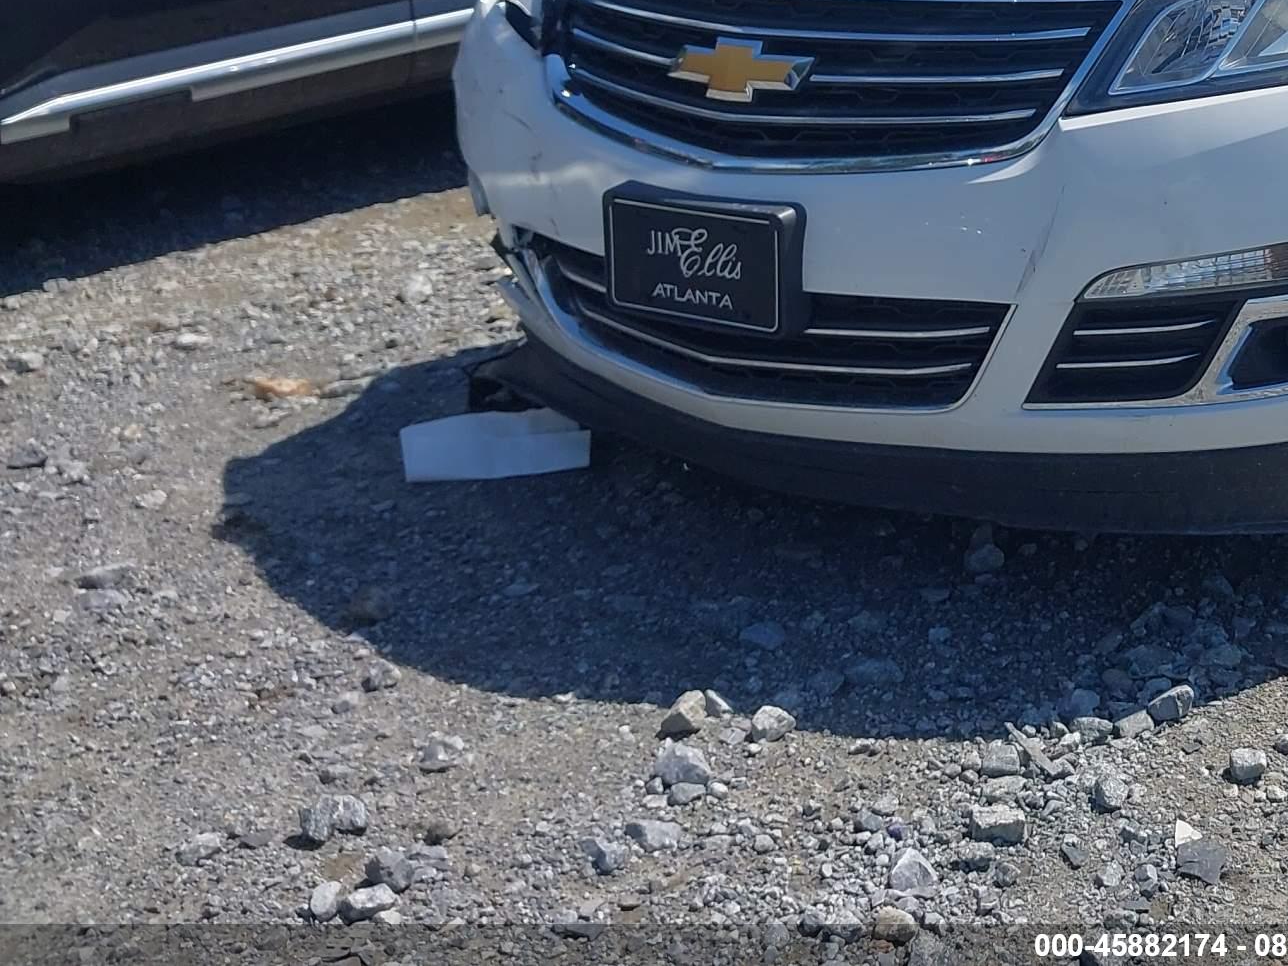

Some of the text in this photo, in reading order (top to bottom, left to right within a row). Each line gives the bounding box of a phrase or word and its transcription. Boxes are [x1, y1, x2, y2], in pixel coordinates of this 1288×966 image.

[646, 227, 743, 280] JIM Ellis
[651, 281, 734, 311] ATLANTA
